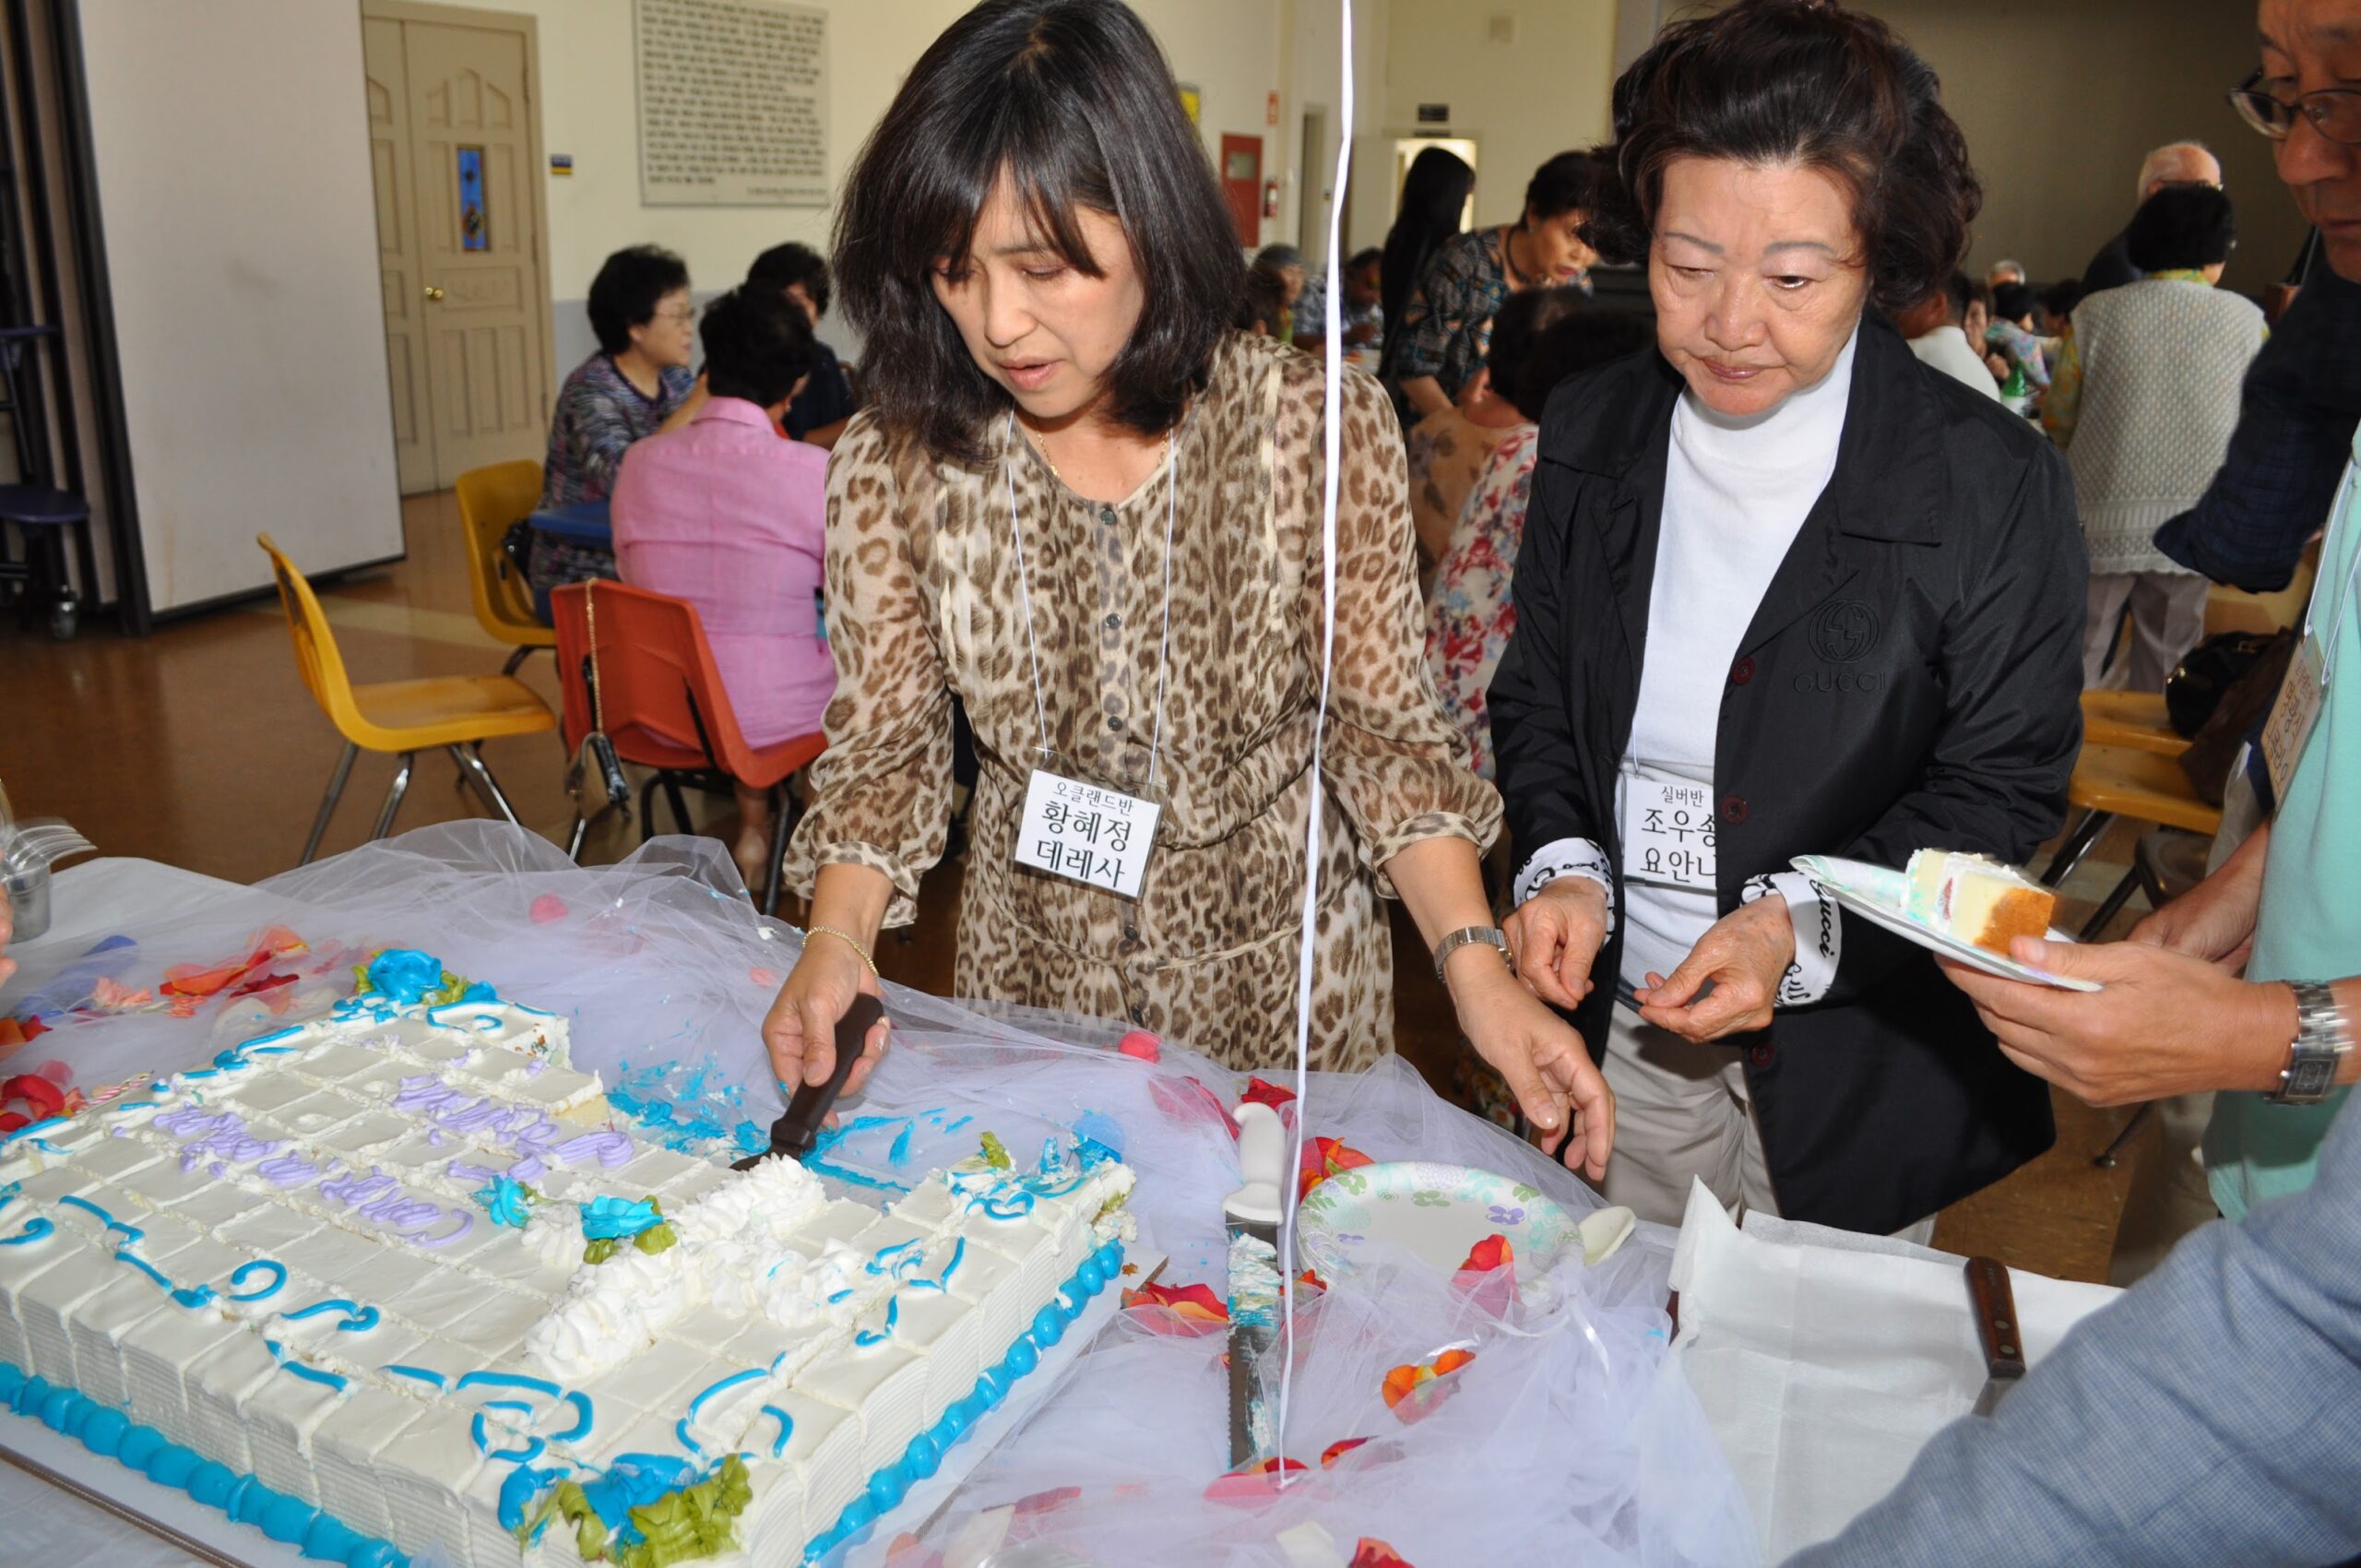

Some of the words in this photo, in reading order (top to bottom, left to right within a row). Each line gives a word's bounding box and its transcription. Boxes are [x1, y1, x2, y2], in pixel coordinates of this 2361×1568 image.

[1793, 671, 1886, 693] GUCCI
[1053, 781, 1134, 816] 오클랜드반
[1661, 786, 1704, 807] 실버반
[1042, 800, 1133, 852] 황혜정
[1037, 839, 1125, 888] 데레사
